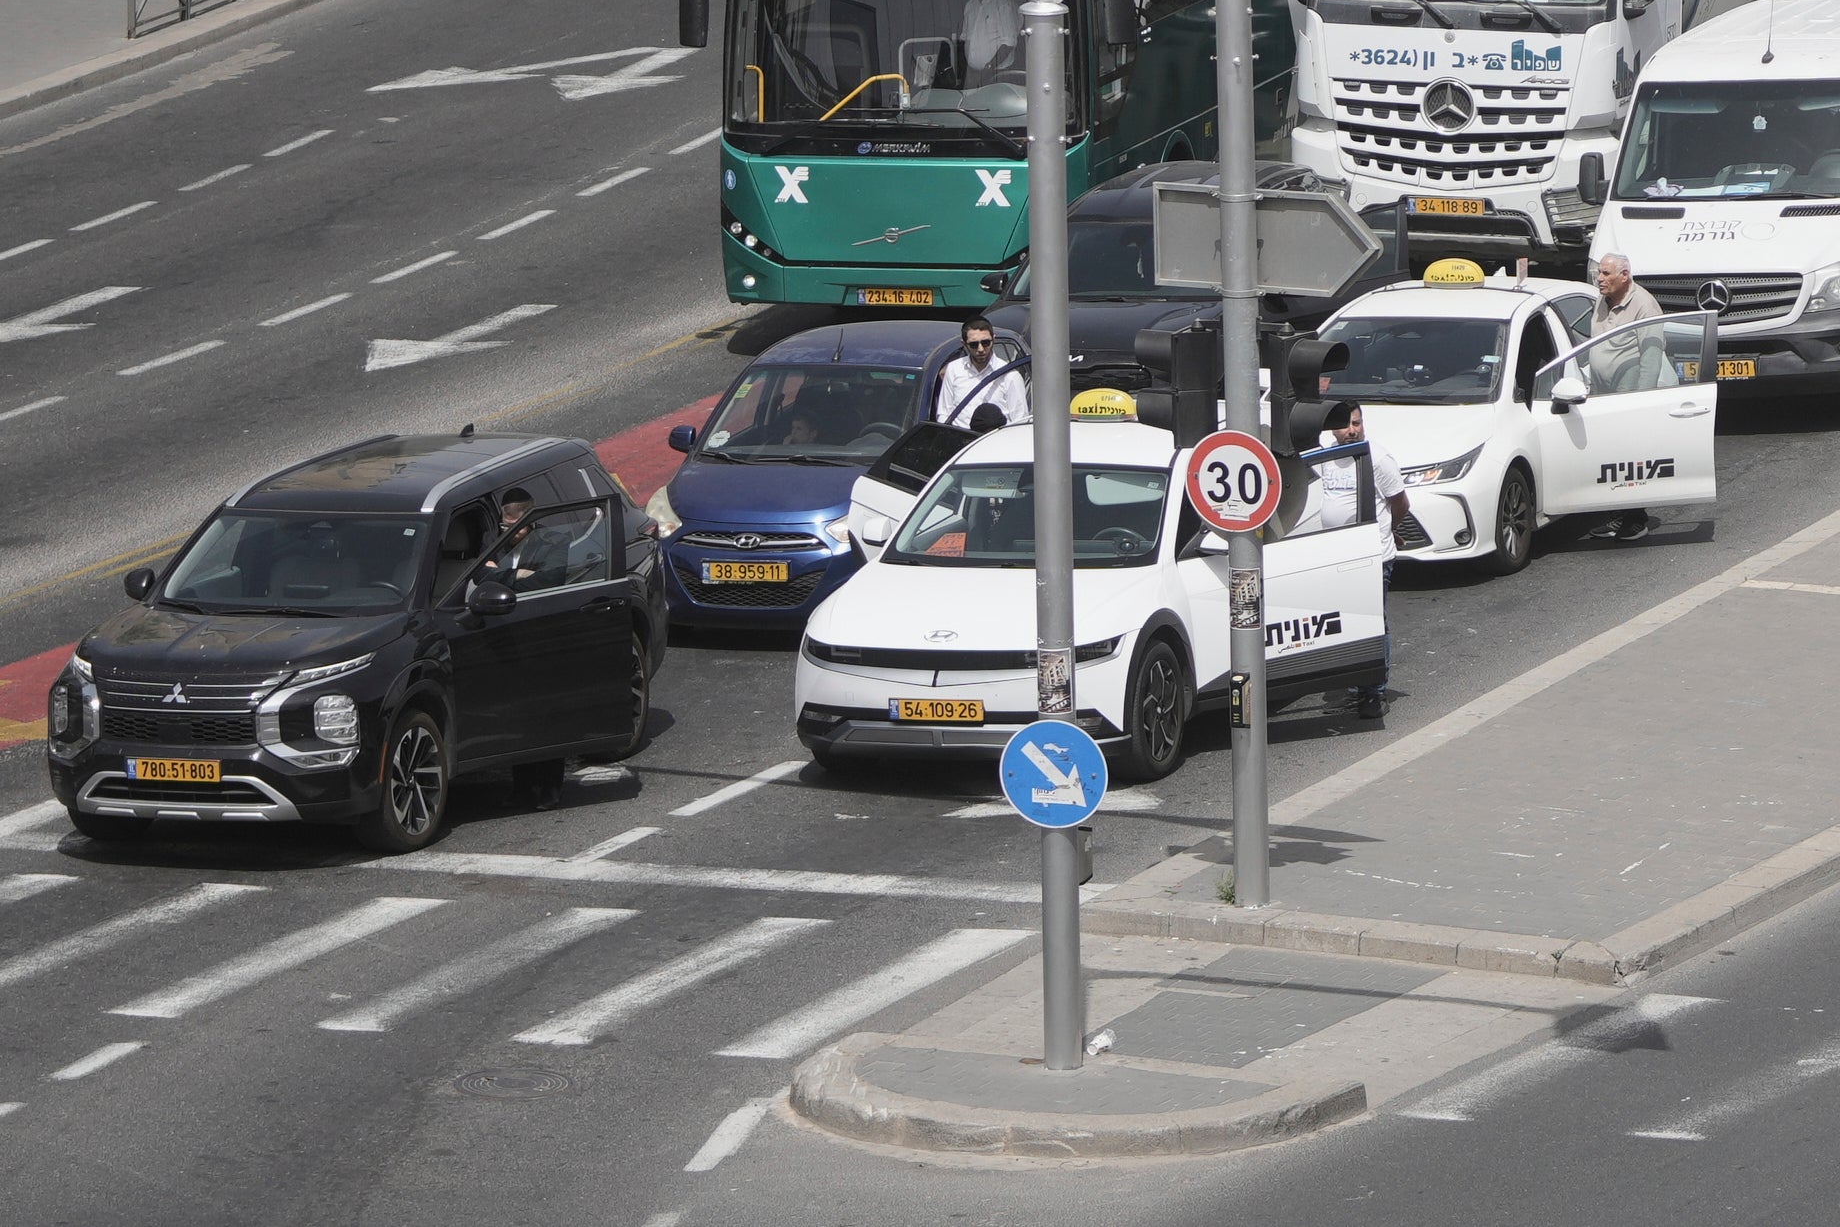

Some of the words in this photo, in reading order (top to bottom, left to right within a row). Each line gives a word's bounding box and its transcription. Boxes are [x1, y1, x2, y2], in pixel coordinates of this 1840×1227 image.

[1681, 219, 1742, 231] קבוצת
[1676, 230, 1736, 243] גורמה
[1078, 402, 1099, 415] taxi
[1099, 405, 1127, 416] מונית
[1597, 458, 1675, 484] מונית
[1207, 461, 1263, 505] 30
[1264, 610, 1342, 648] מונית
